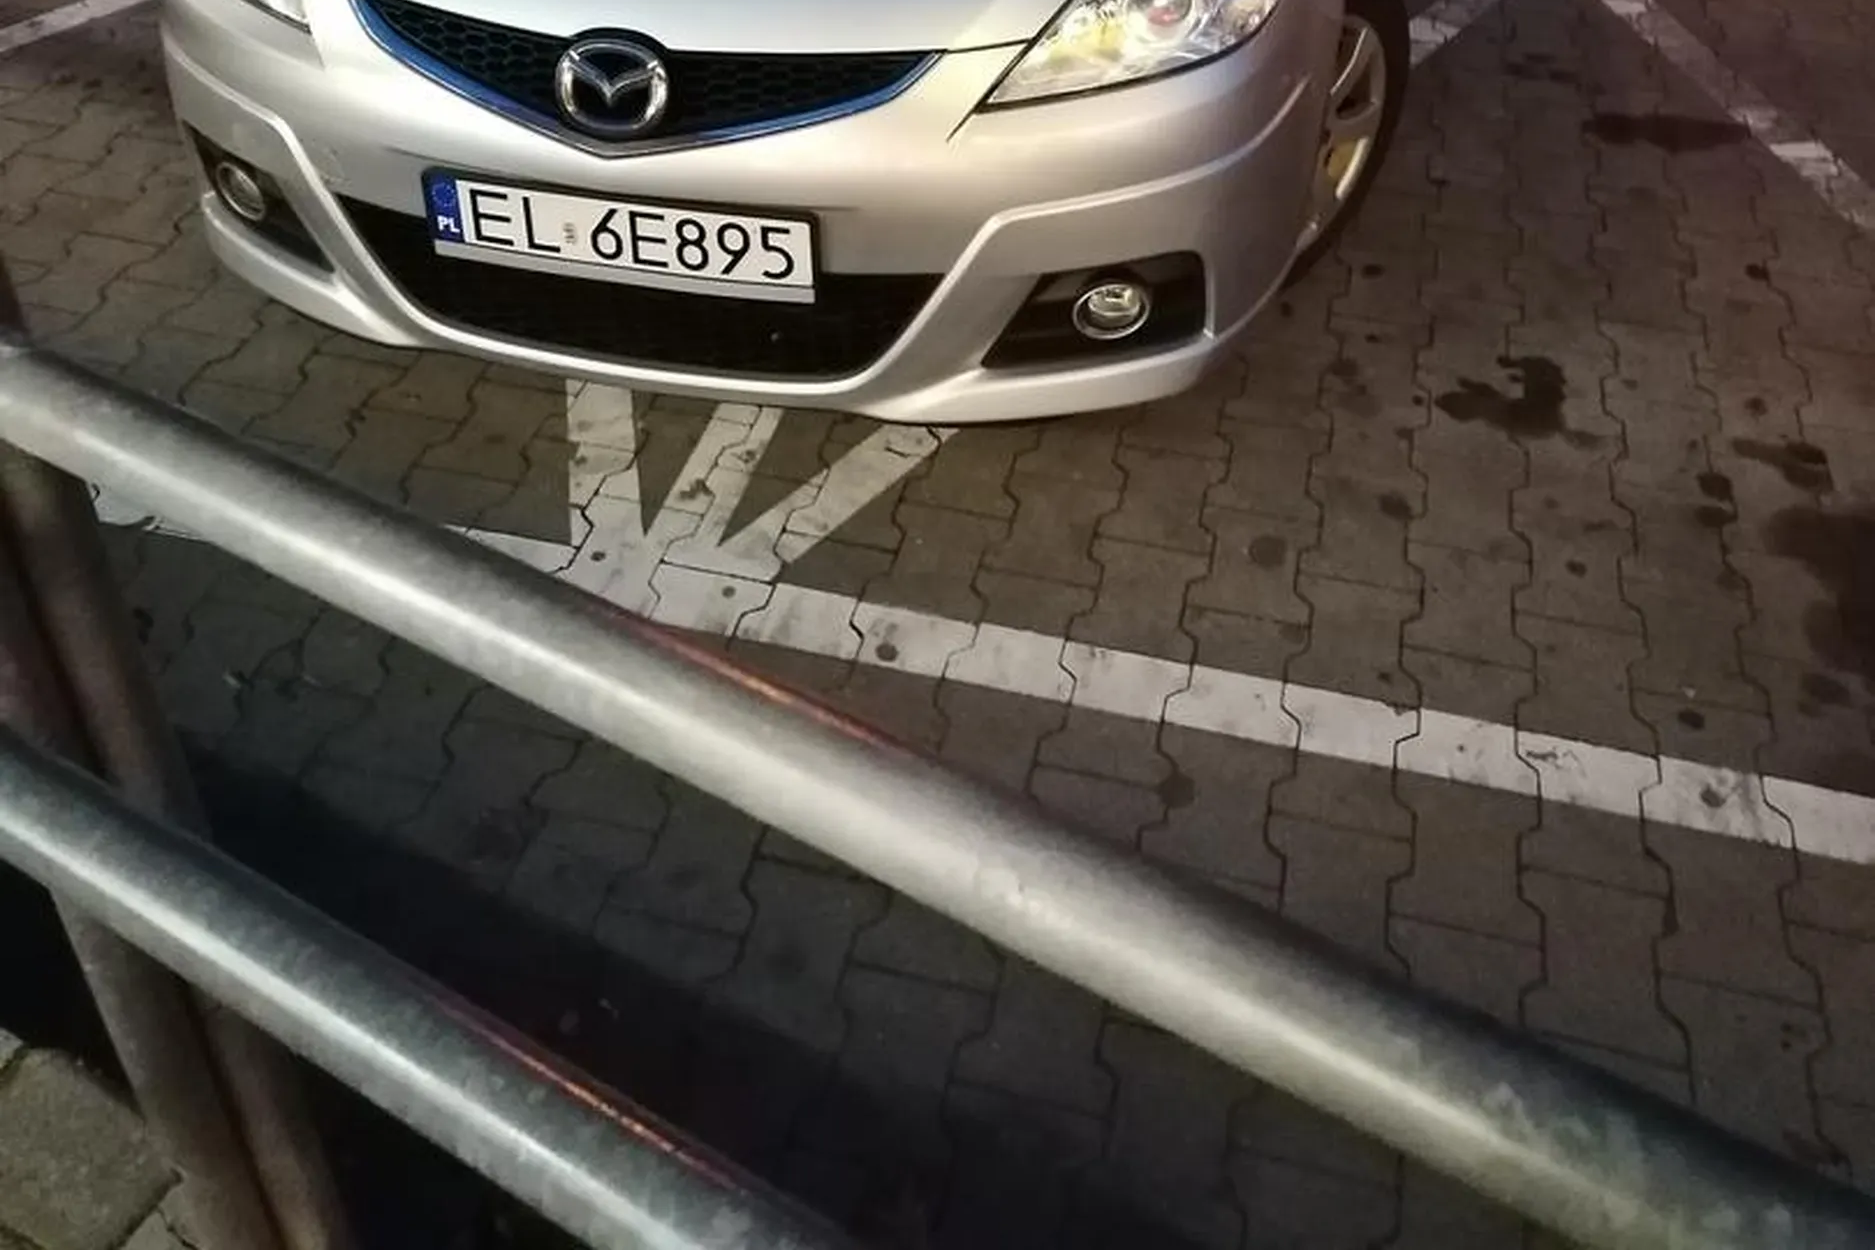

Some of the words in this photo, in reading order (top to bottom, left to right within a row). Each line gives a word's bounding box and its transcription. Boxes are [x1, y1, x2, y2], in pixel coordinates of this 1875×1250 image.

[437, 216, 461, 234] PL
[469, 188, 561, 254] EL
[590, 207, 795, 281] 6E895
